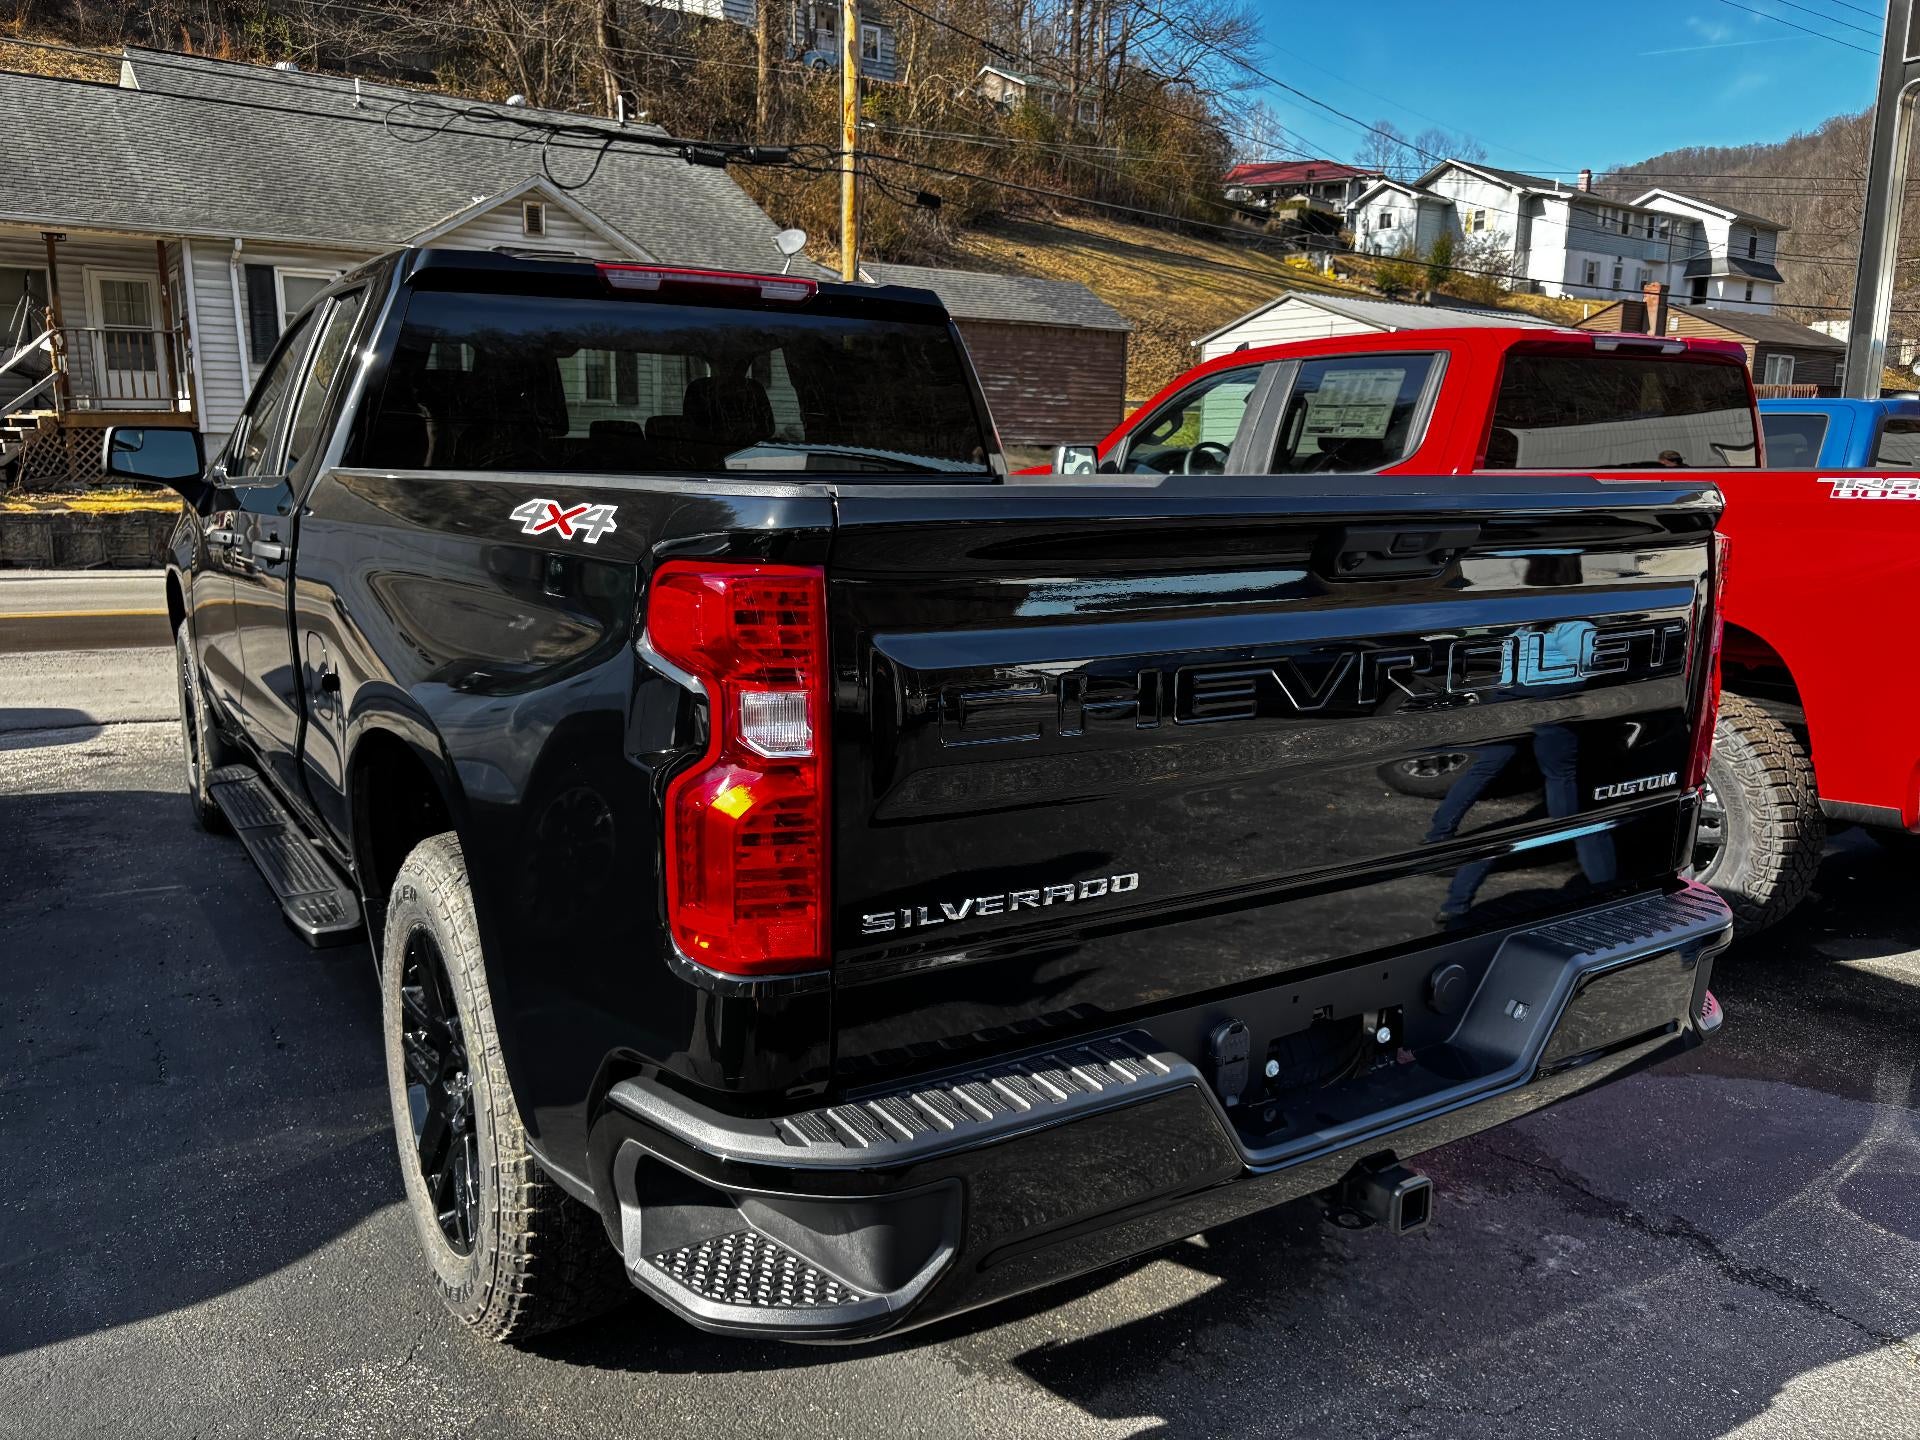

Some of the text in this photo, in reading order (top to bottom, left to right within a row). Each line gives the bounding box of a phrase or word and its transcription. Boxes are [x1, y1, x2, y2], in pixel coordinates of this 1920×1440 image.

[940, 617, 1685, 747] CHEVROLET
[1594, 772, 1677, 800] CUSTOM
[862, 872, 1139, 934] SILVERADO
